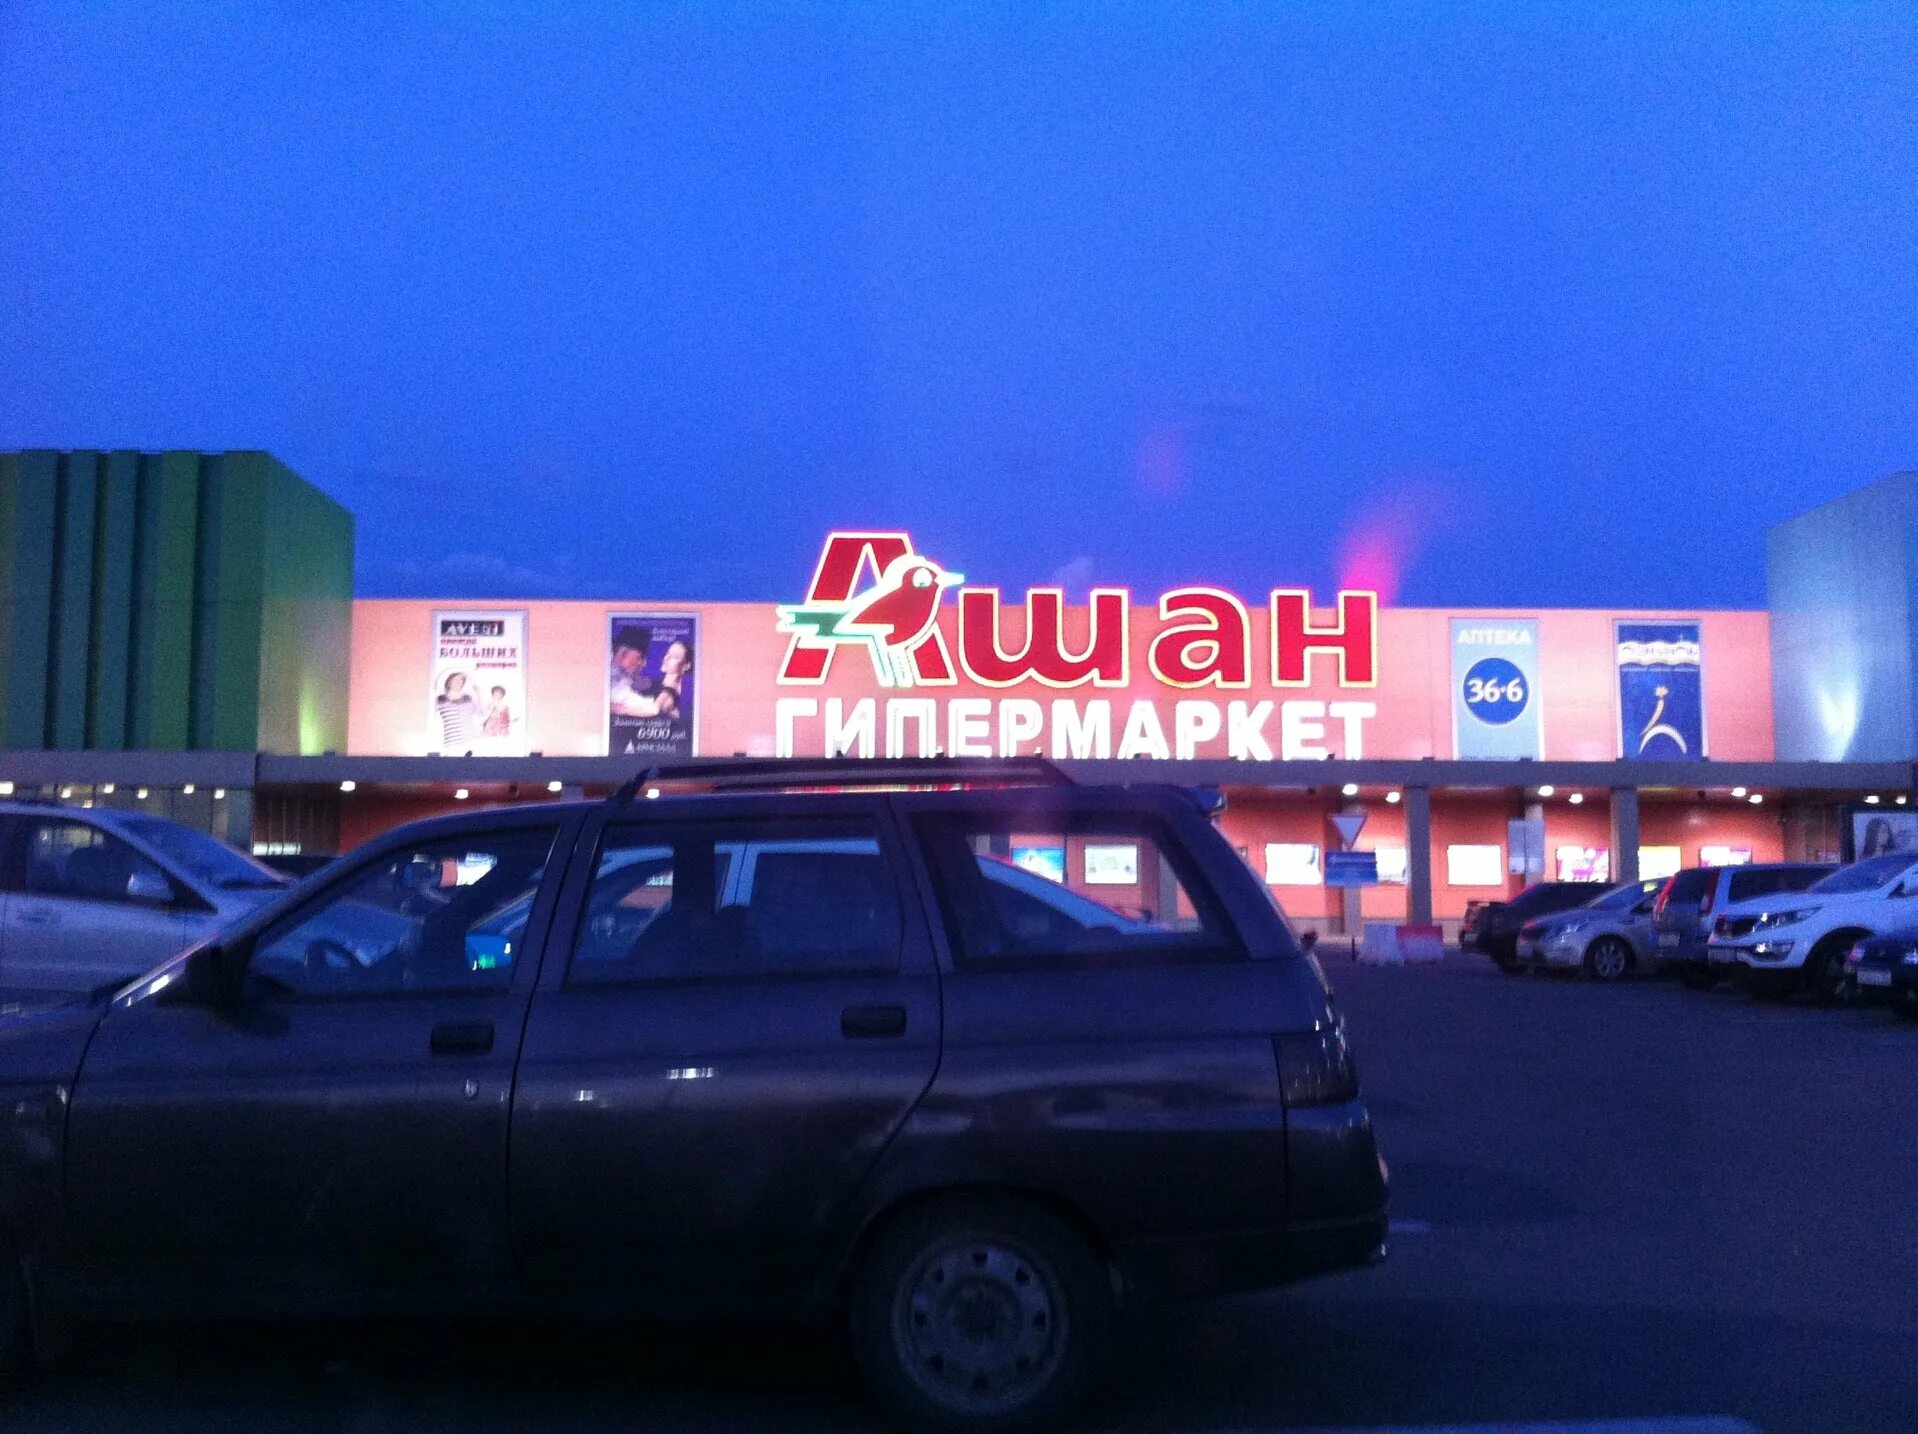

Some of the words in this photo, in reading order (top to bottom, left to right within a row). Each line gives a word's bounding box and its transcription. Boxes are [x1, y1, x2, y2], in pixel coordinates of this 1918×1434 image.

[776, 531, 1379, 688] Ашан
[439, 647, 517, 659] БОЛЬШИХ
[1457, 628, 1532, 645] АПТЕКА
[775, 697, 1377, 761] ГИПЕРМАРКЕТ
